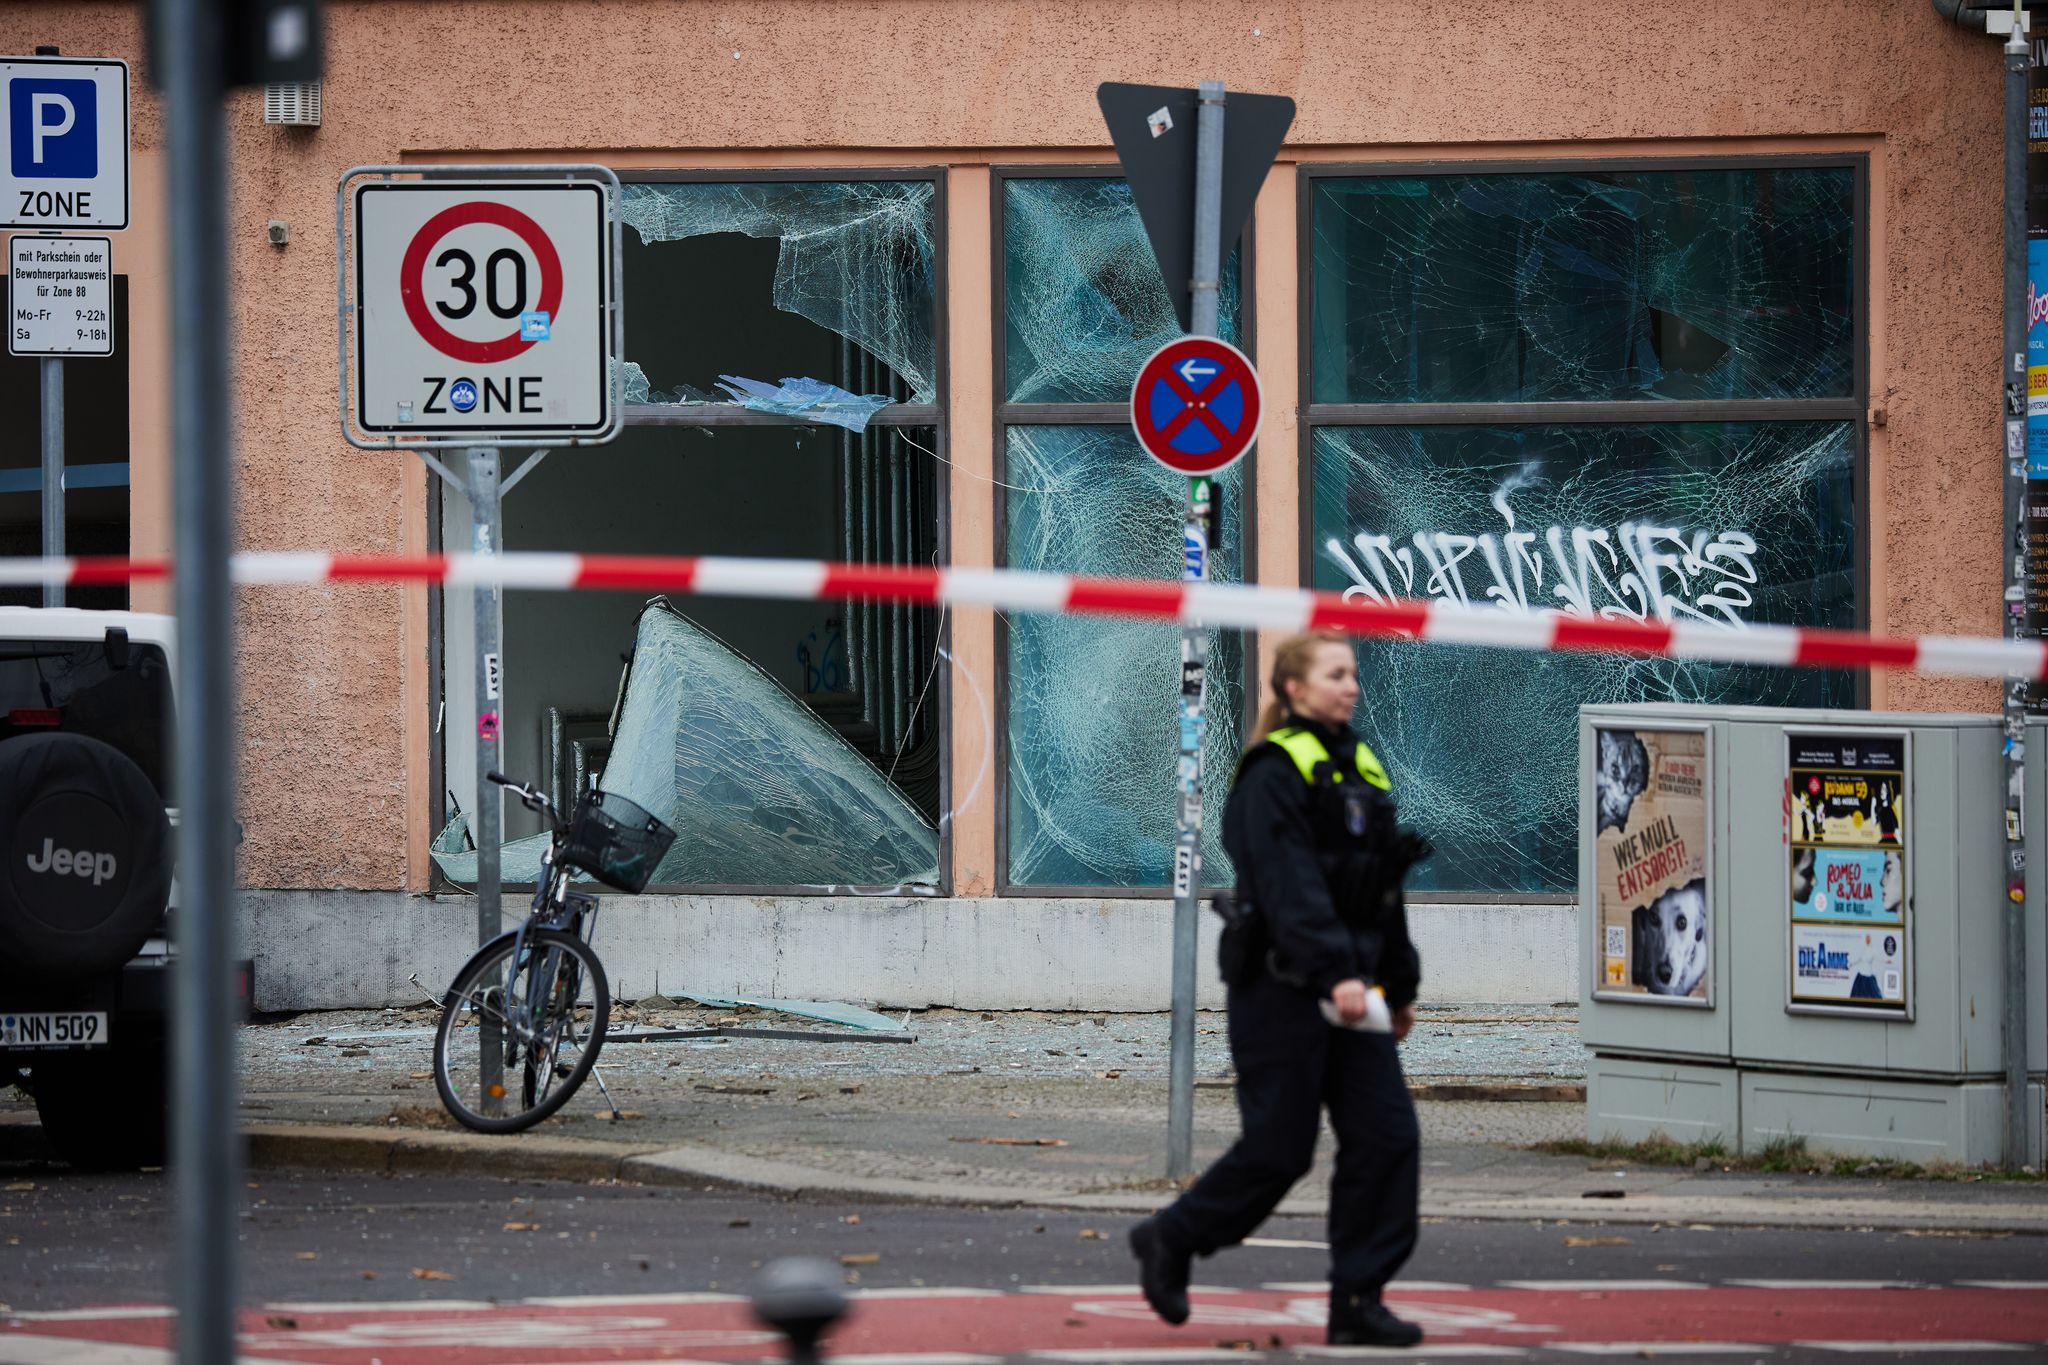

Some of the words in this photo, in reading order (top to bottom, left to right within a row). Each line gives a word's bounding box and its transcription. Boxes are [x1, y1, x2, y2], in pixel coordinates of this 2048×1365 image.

[31, 92, 76, 164] P
[19, 191, 91, 218] ZONE
[19, 251, 33, 262] mit
[36, 250, 81, 263] Parkschein
[84, 251, 103, 263] oder
[15, 267, 107, 282] Bewohnerparkausweis
[435, 247, 527, 320] 30
[37, 285, 49, 297] für
[53, 285, 73, 297] Zone
[76, 286, 86, 298] 88
[17, 309, 52, 321] Mo-Fr
[75, 309, 106, 321] 9-22h
[16, 328, 30, 340] Sa
[77, 329, 107, 340] 9-18h
[490, 657, 498, 693] EASY
[27, 837, 117, 886] Jeep
[1612, 834, 1642, 871] WIE
[1827, 863, 1861, 893] ROMEO
[1836, 883, 1845, 898] &
[1845, 882, 1873, 900] JULIA
[1798, 949, 1816, 969] DIE
[1818, 942, 1849, 970] AMME
[20, 1015, 50, 1042] NN
[55, 1014, 98, 1042] 509
